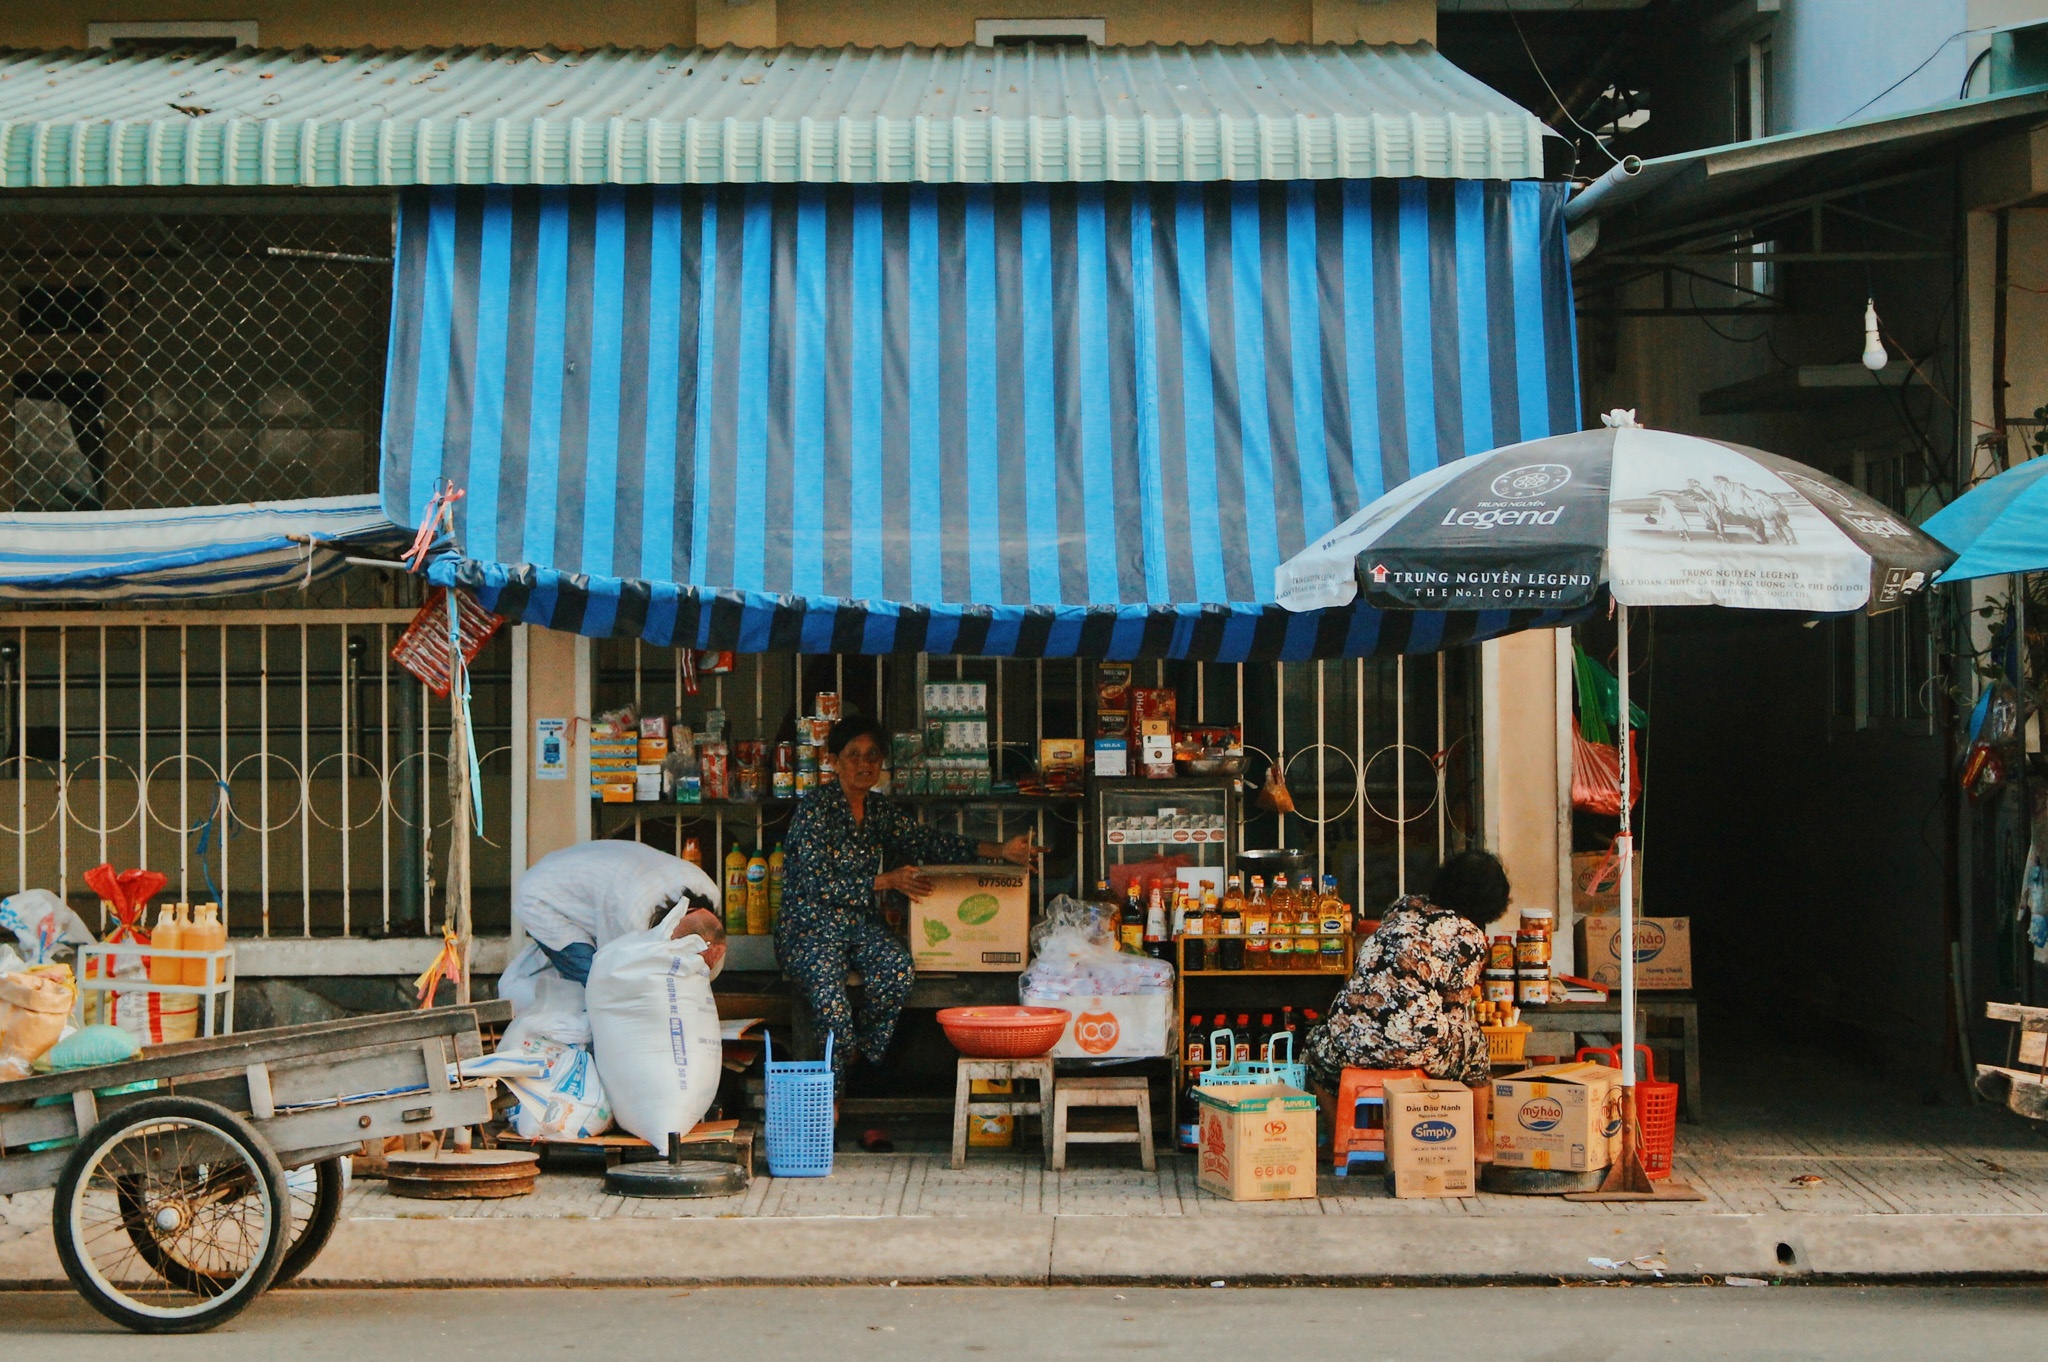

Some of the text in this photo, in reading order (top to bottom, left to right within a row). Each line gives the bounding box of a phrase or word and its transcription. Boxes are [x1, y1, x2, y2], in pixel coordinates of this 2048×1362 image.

[1441, 506, 1565, 530] Legend
[1394, 571, 1591, 586] TRUNG NGUYÊN LEGEND
[1682, 569, 1713, 577] TRUNG
[1760, 571, 1799, 580] LEGEND
[1415, 588, 1448, 598] THE
[1492, 589, 1563, 600] COFFEE!
[978, 878, 1023, 888] 67756025
[1078, 1022, 1117, 1040] 100
[678, 1068, 686, 1077] 50
[1416, 1124, 1454, 1139] Simply
